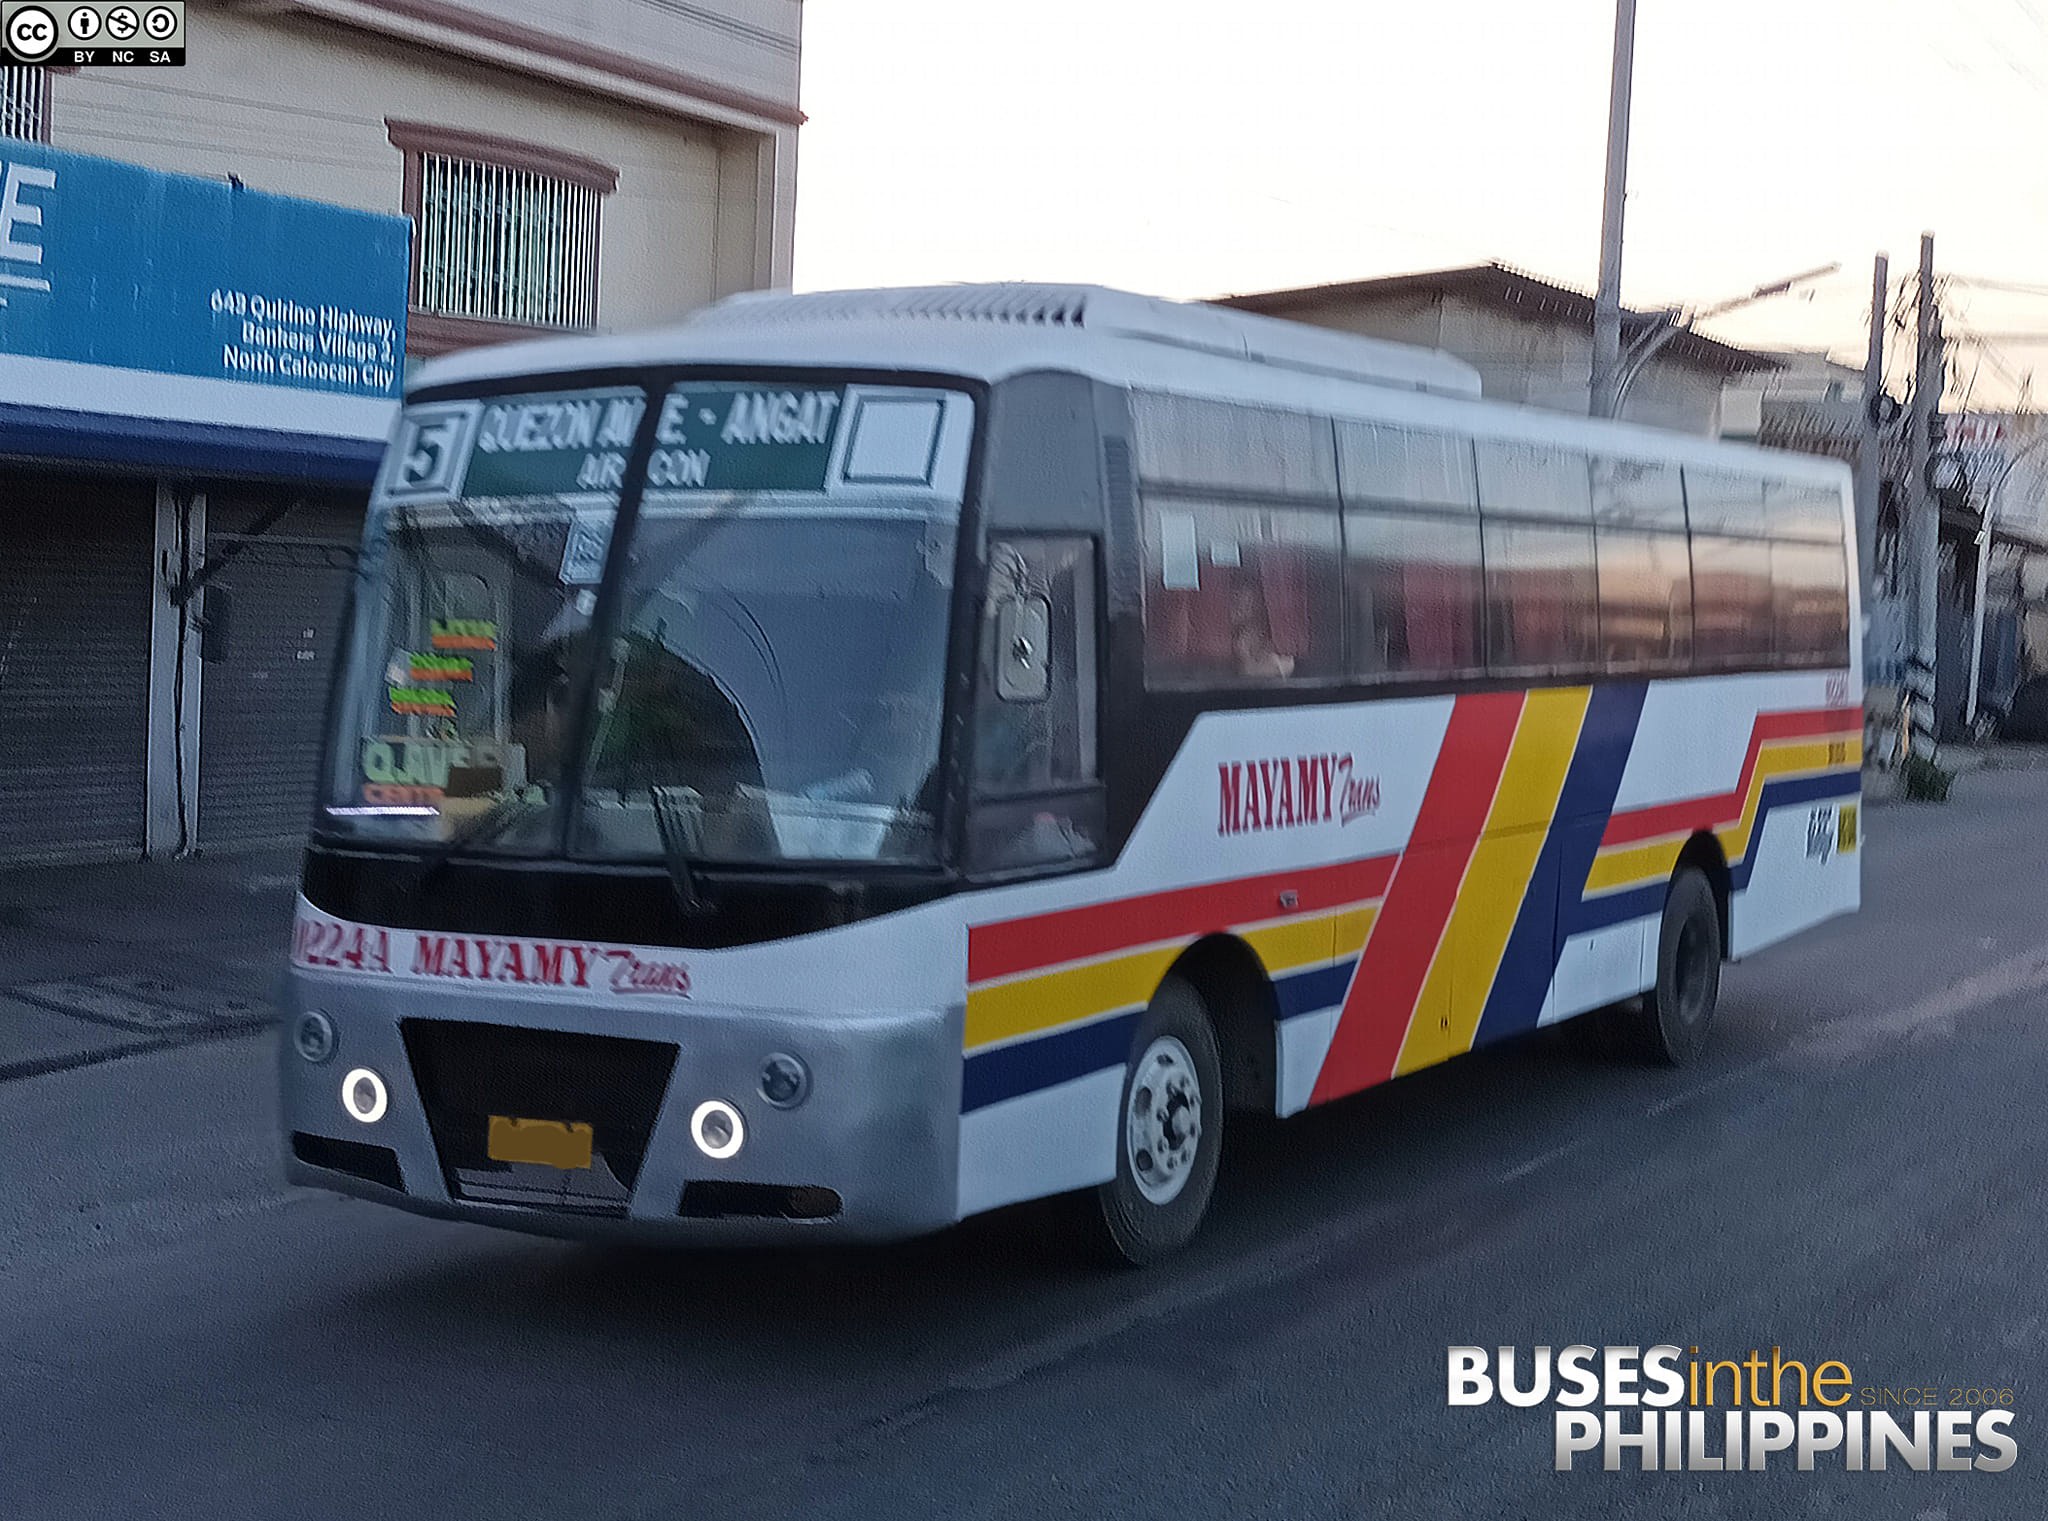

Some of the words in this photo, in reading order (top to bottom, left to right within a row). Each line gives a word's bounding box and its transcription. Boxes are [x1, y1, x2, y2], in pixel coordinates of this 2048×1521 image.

[250, 293, 317, 331] Quirino
[223, 343, 275, 374] North
[279, 351, 358, 385] Caloocan
[362, 363, 394, 393] City
[318, 329, 377, 364] Village
[478, 400, 602, 453] QUEZON
[720, 390, 840, 445] ANGAT
[1216, 751, 1340, 837] MAYAMY
[411, 935, 599, 990] MAYAMY
